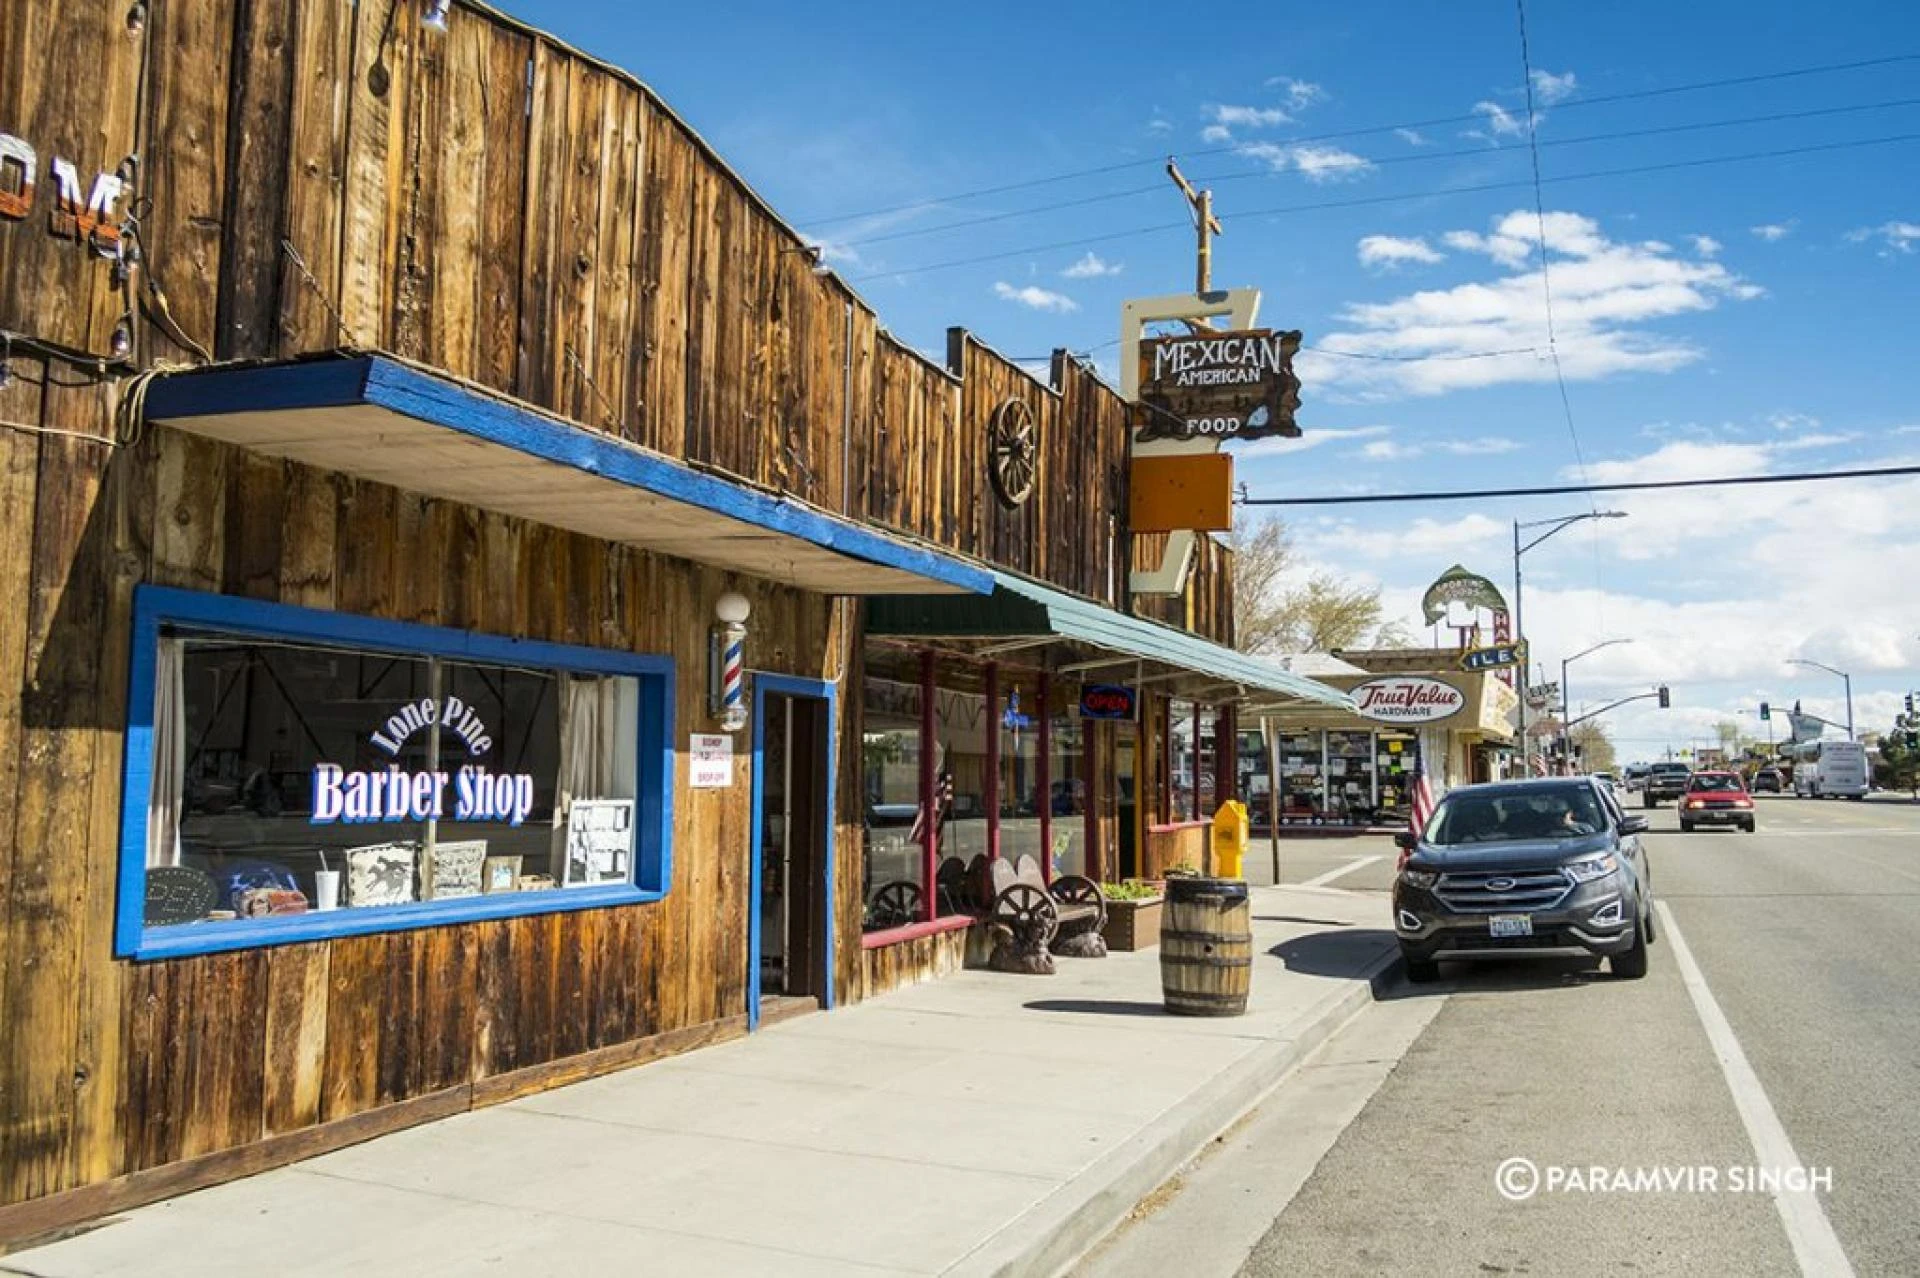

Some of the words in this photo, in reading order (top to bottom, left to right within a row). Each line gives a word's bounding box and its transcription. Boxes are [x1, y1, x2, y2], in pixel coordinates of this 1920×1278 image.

[1155, 337, 1282, 381] MEXICAN
[1176, 368, 1261, 387] AMERICAN
[1187, 418, 1240, 434] FOOD
[369, 698, 436, 757] Lone
[440, 696, 493, 756] Pine
[1374, 706, 1431, 716] HARDWARE
[309, 762, 449, 825] Barber
[455, 764, 533, 828] Shop
